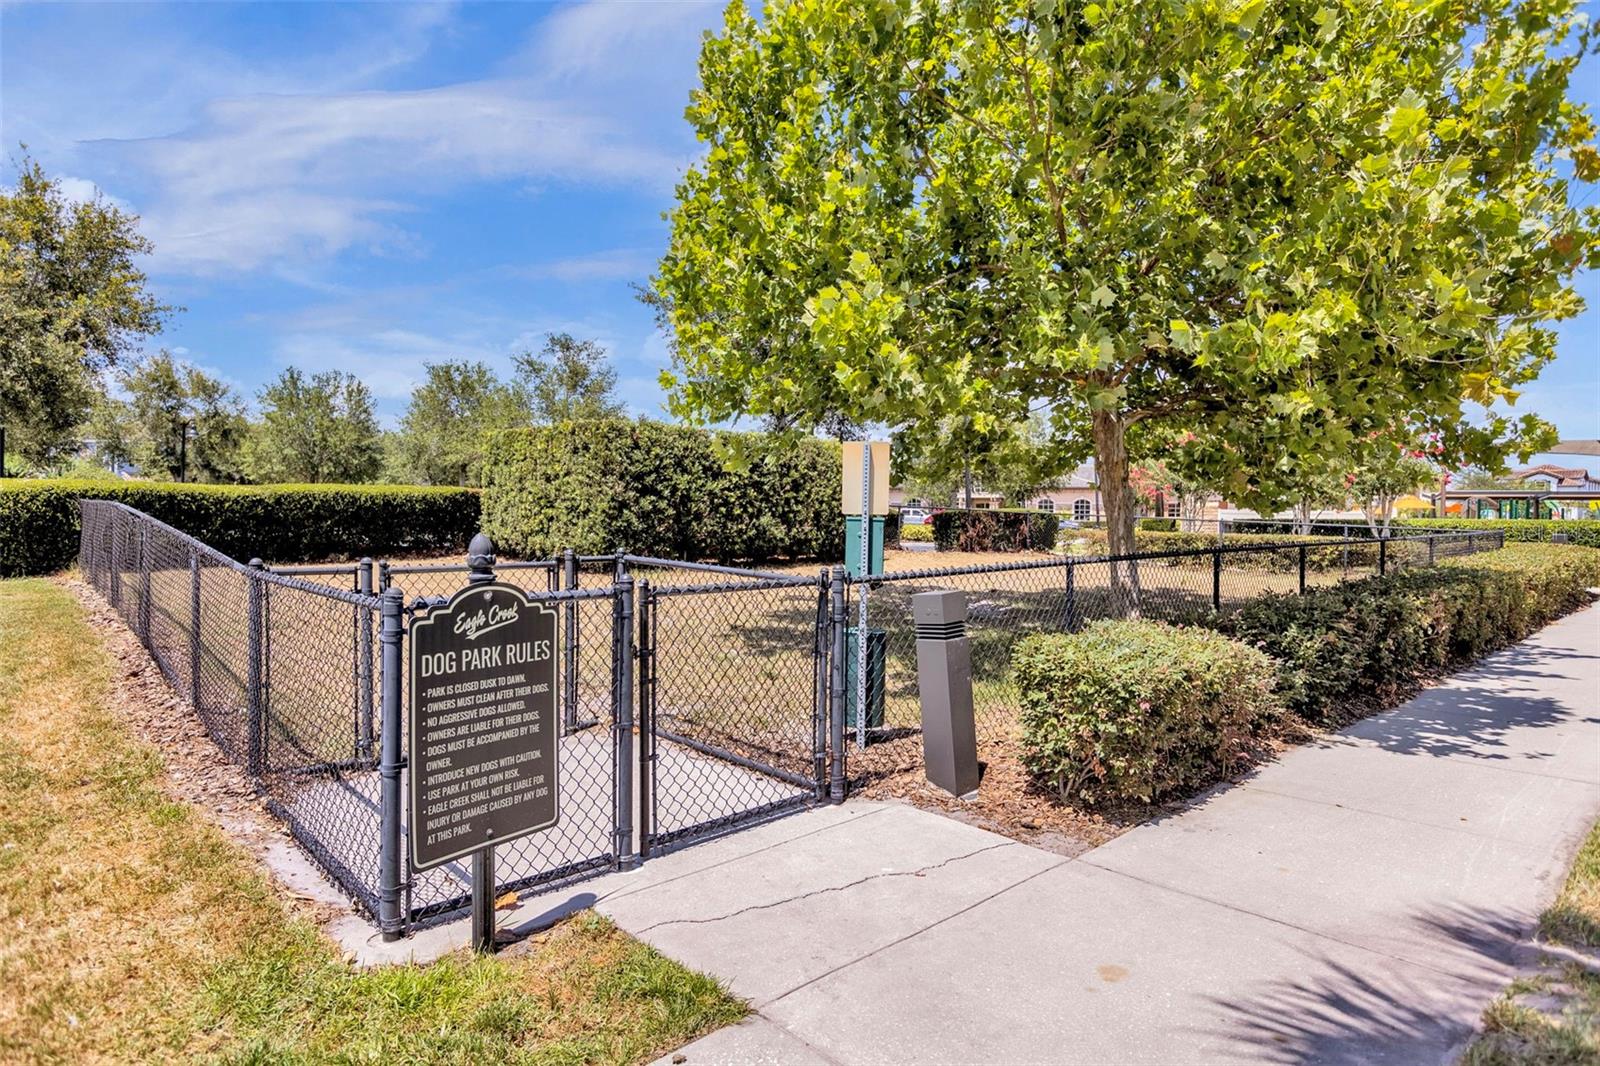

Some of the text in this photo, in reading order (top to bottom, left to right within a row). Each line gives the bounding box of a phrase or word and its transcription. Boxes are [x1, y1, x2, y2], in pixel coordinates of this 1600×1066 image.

[454, 602, 518, 634] Eagle Creek
[422, 640, 550, 677] DOG PARK RULES
[427, 686, 445, 698] PARK
[447, 685, 453, 694] IS
[455, 681, 478, 693] CLOSED
[480, 678, 496, 689] DUSK
[498, 677, 505, 686] TO
[427, 699, 455, 712] OWNERS
[457, 696, 474, 707] MUST
[476, 693, 494, 704] CLEAN
[496, 689, 513, 700] AFTER
[515, 686, 530, 696] THEIR
[427, 717, 436, 727] NO
[438, 709, 477, 725] AGGRESSIVE
[479, 706, 495, 717] DOGS
[427, 728, 455, 741] OWNERS
[457, 725, 468, 735] ARE
[470, 721, 490, 732] LIABLE
[492, 718, 503, 728] FOR
[505, 715, 521, 725] THEIR
[427, 724, 539, 756] DOGS MUST BE ACCOMPANIED BY THE
[428, 768, 464, 785] INTRODUCE
[466, 765, 480, 776] NEW
[481, 760, 498, 772] DOGS
[499, 756, 514, 768] WITH
[428, 788, 440, 800] USE
[442, 784, 459, 796] PARK
[461, 781, 469, 791] AT
[470, 777, 487, 789] YOUR
[489, 773, 503, 784] OWN
[428, 776, 543, 815] EAGLE CREEK SHALL NOT BE LIABLE FOR
[427, 788, 547, 830] INJURY OR DAMAGE CAUSED BY ANY DOG
[427, 833, 436, 845] AT
[437, 828, 452, 842] THIS
